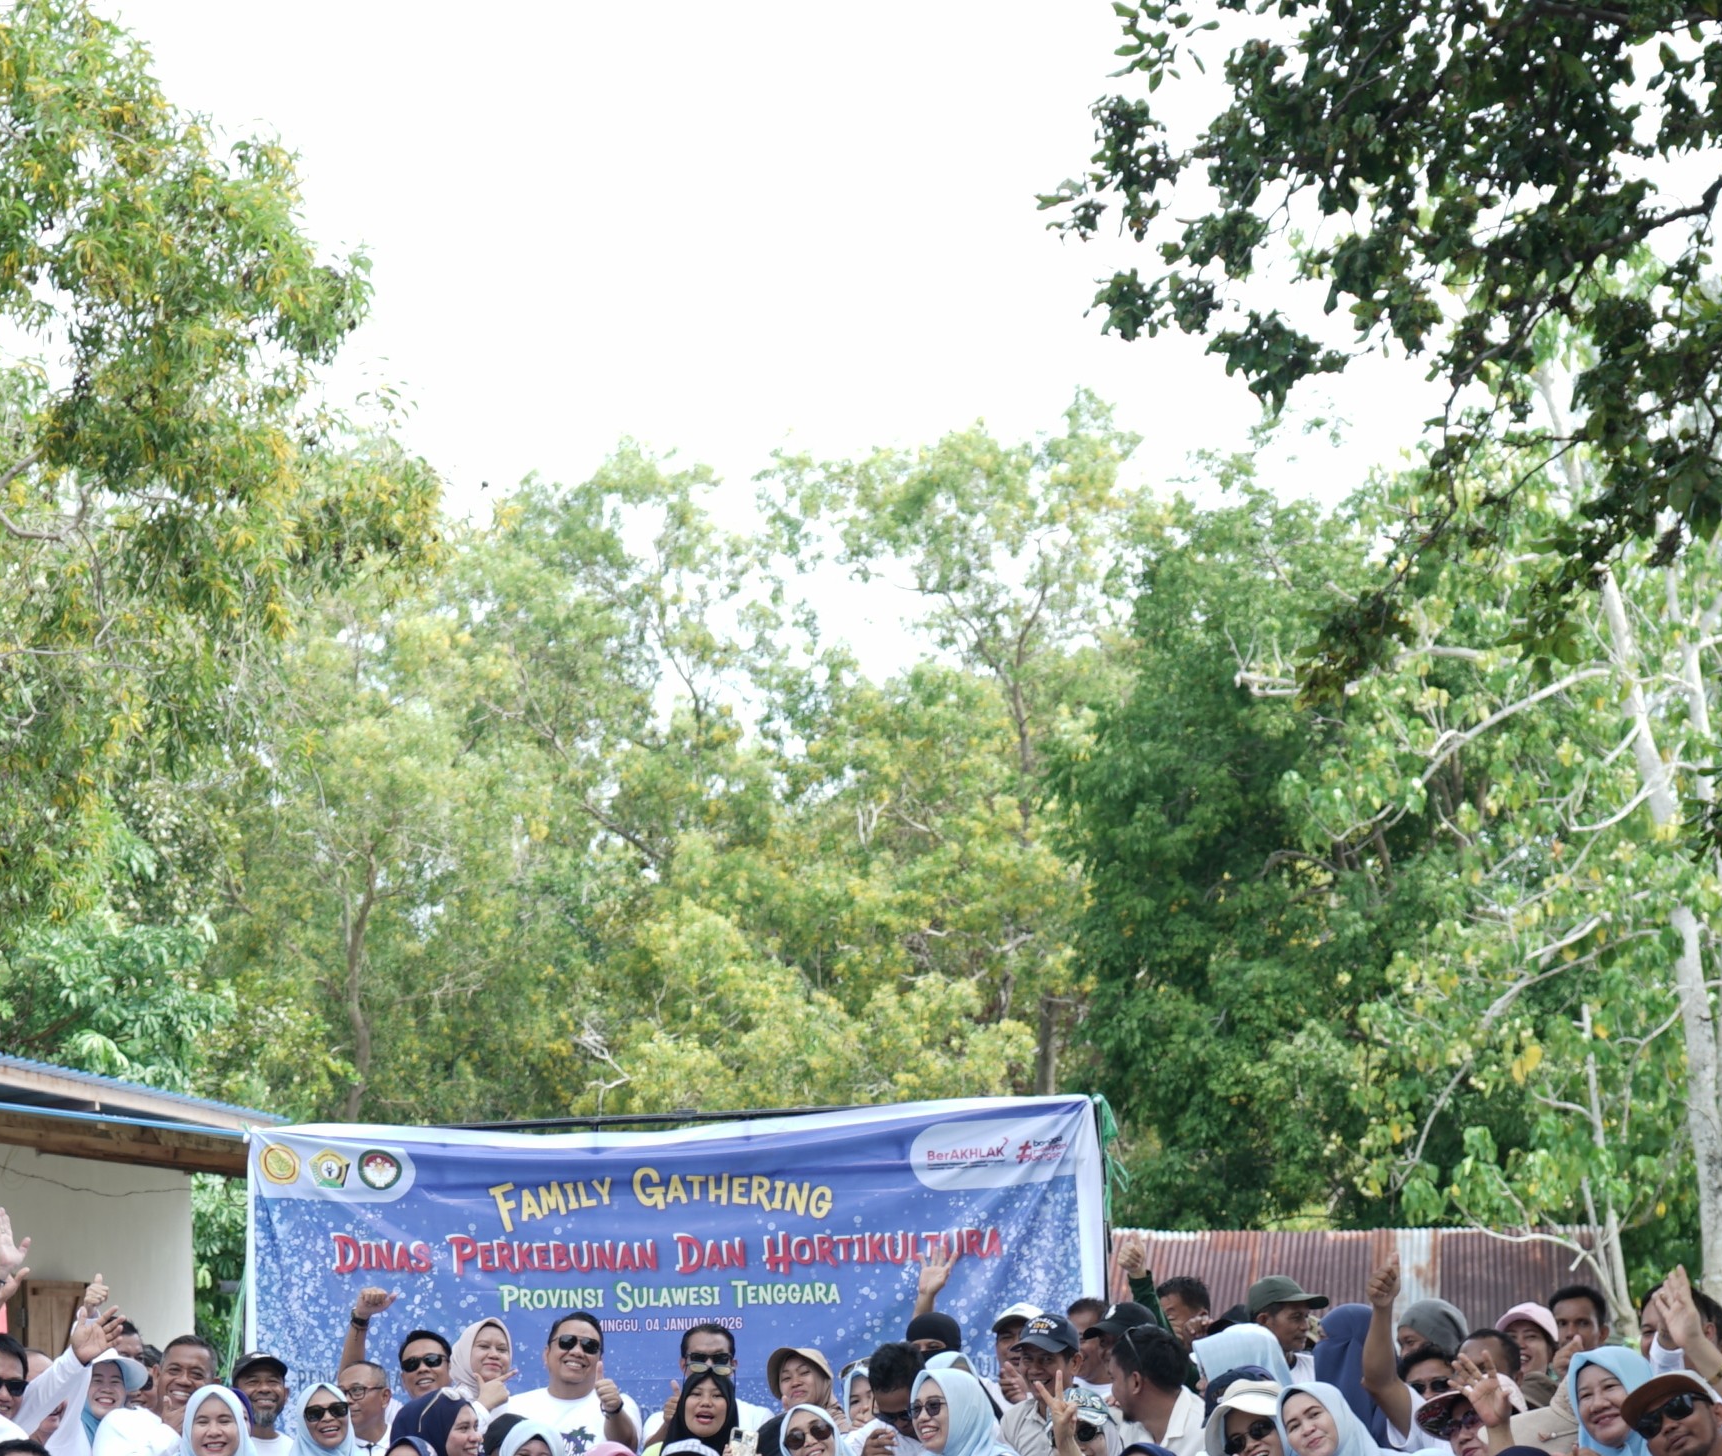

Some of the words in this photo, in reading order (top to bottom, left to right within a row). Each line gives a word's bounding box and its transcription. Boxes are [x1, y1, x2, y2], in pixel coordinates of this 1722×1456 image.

[331, 1231, 433, 1273] DINAS
[445, 1233, 658, 1275] PERKEBUNAN
[673, 1232, 746, 1274] DAN
[762, 1226, 1002, 1275] HORTIKULTURA
[499, 1284, 604, 1312] PROVINSI
[616, 1281, 720, 1312] SULAWESI
[731, 1280, 841, 1308] TENGGARA
[645, 1319, 660, 1331] 04
